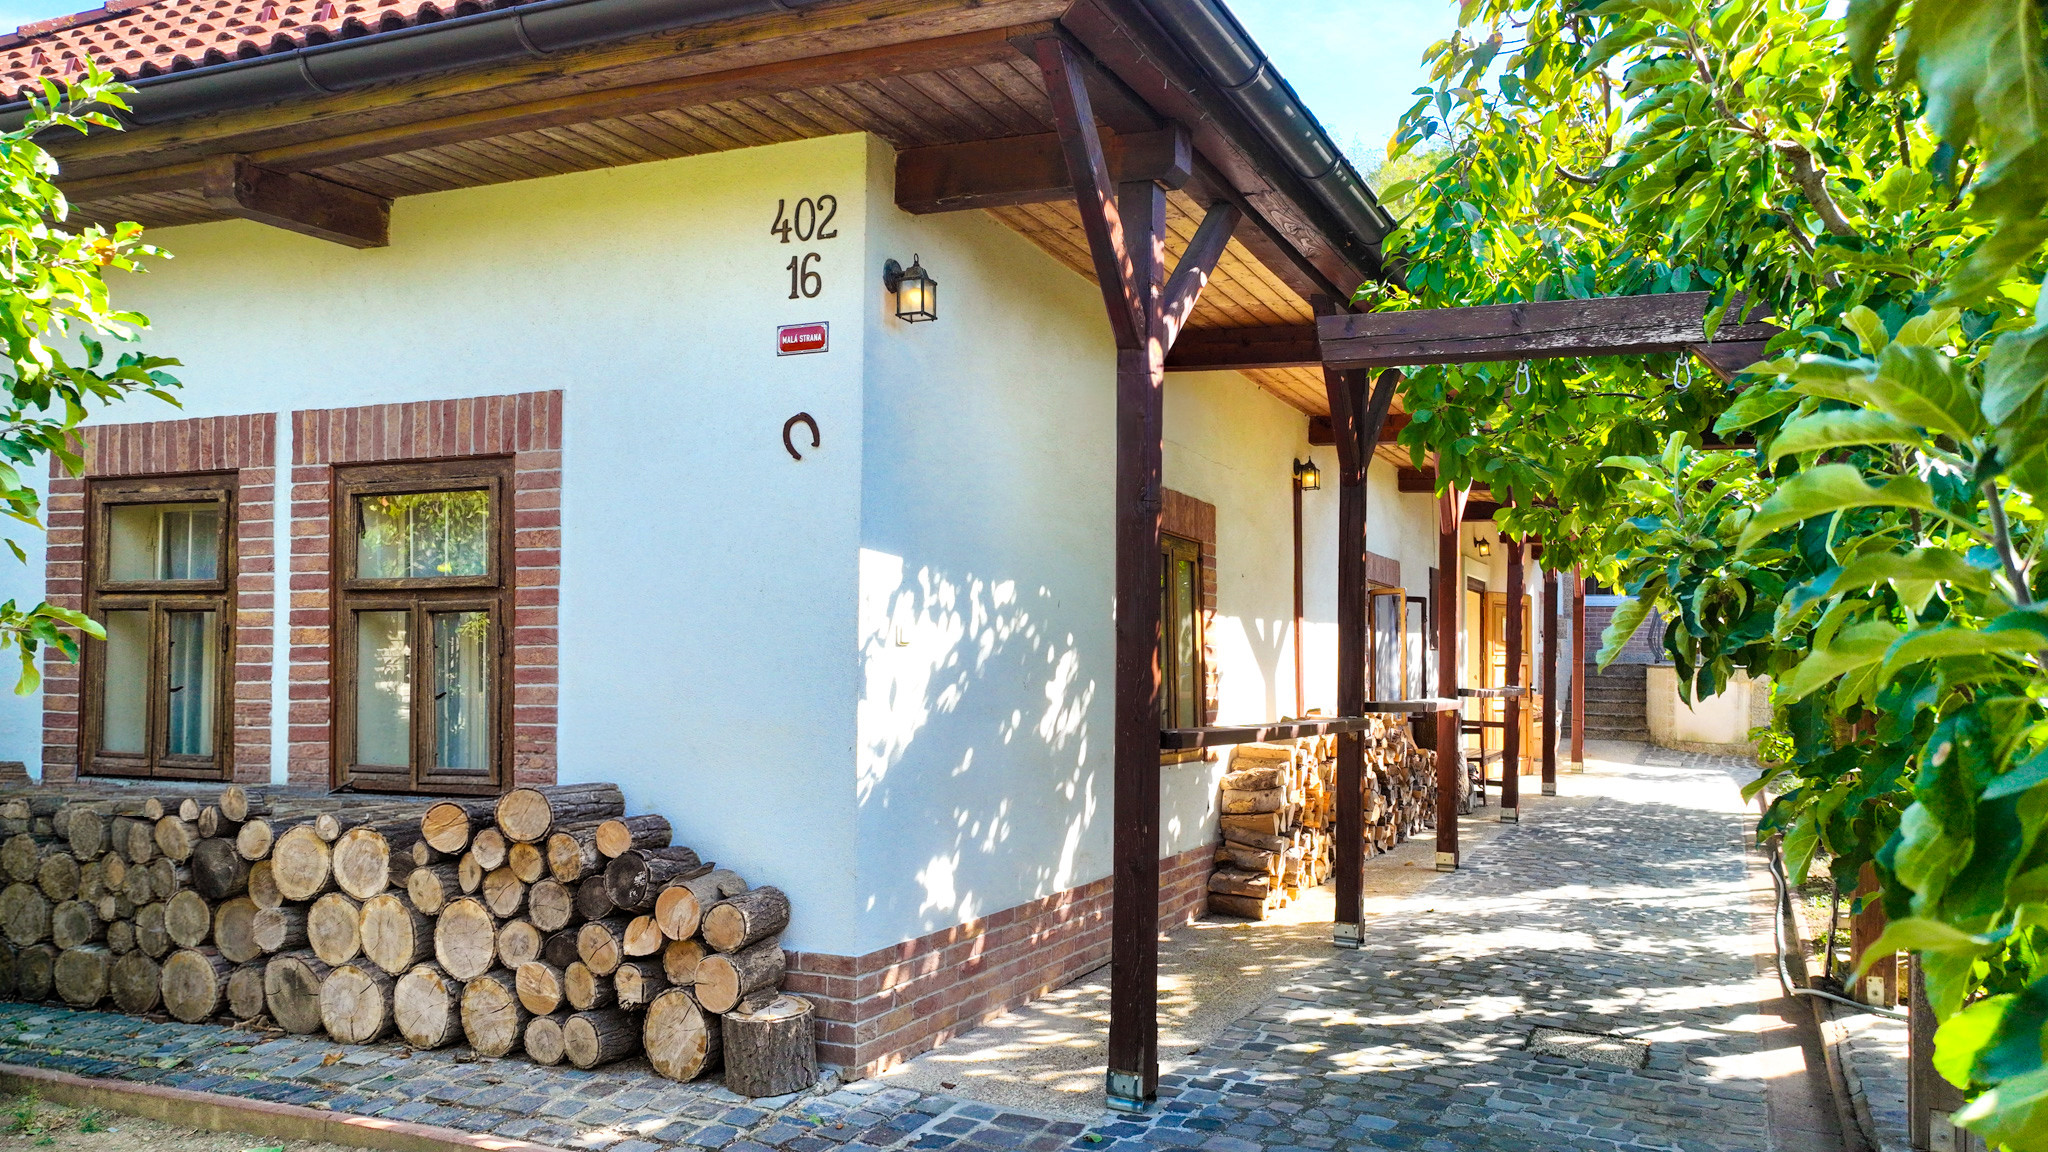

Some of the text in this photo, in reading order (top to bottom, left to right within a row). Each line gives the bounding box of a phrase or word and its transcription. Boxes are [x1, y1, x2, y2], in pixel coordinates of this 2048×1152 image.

[770, 194, 838, 243] 402
[786, 252, 822, 299] 16
[782, 333, 822, 344] MALÁ STRANA
